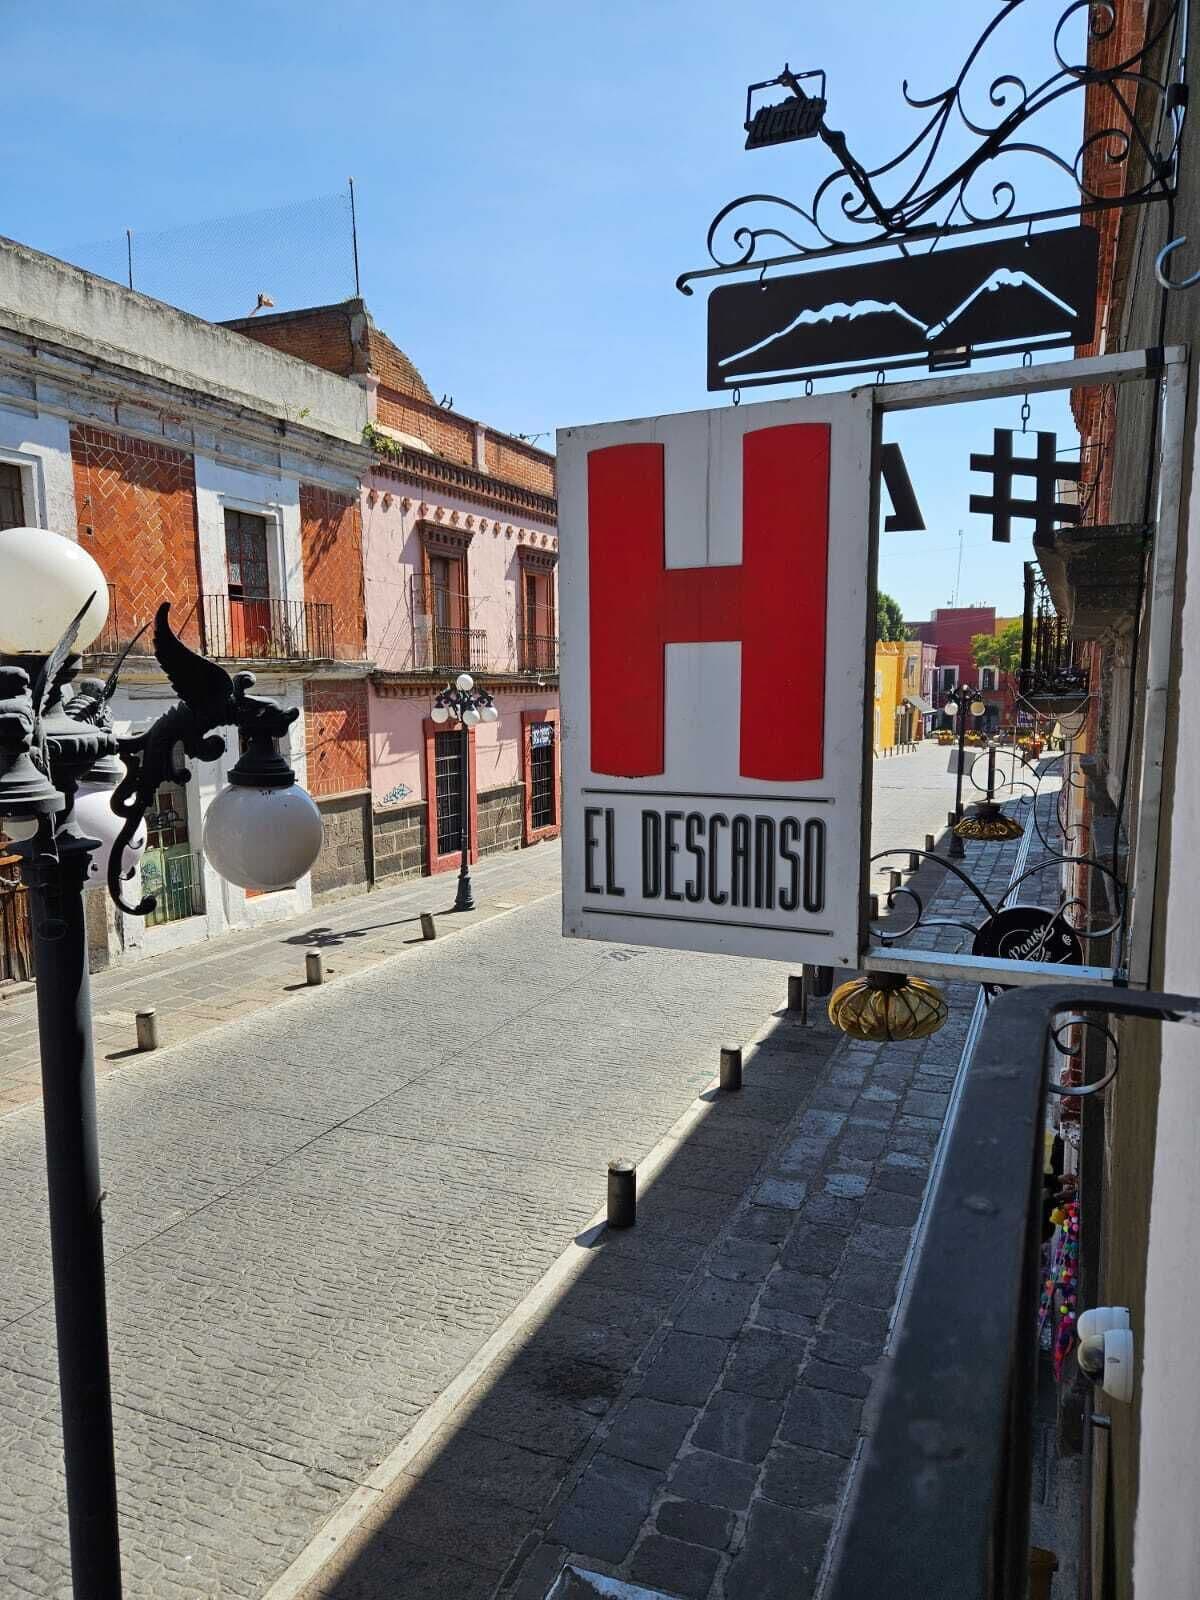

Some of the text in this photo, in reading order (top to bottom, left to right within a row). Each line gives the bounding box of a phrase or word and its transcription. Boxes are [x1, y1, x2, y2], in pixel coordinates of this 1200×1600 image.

[588, 423, 830, 780] H
[584, 807, 826, 914] EL DESCANSO
